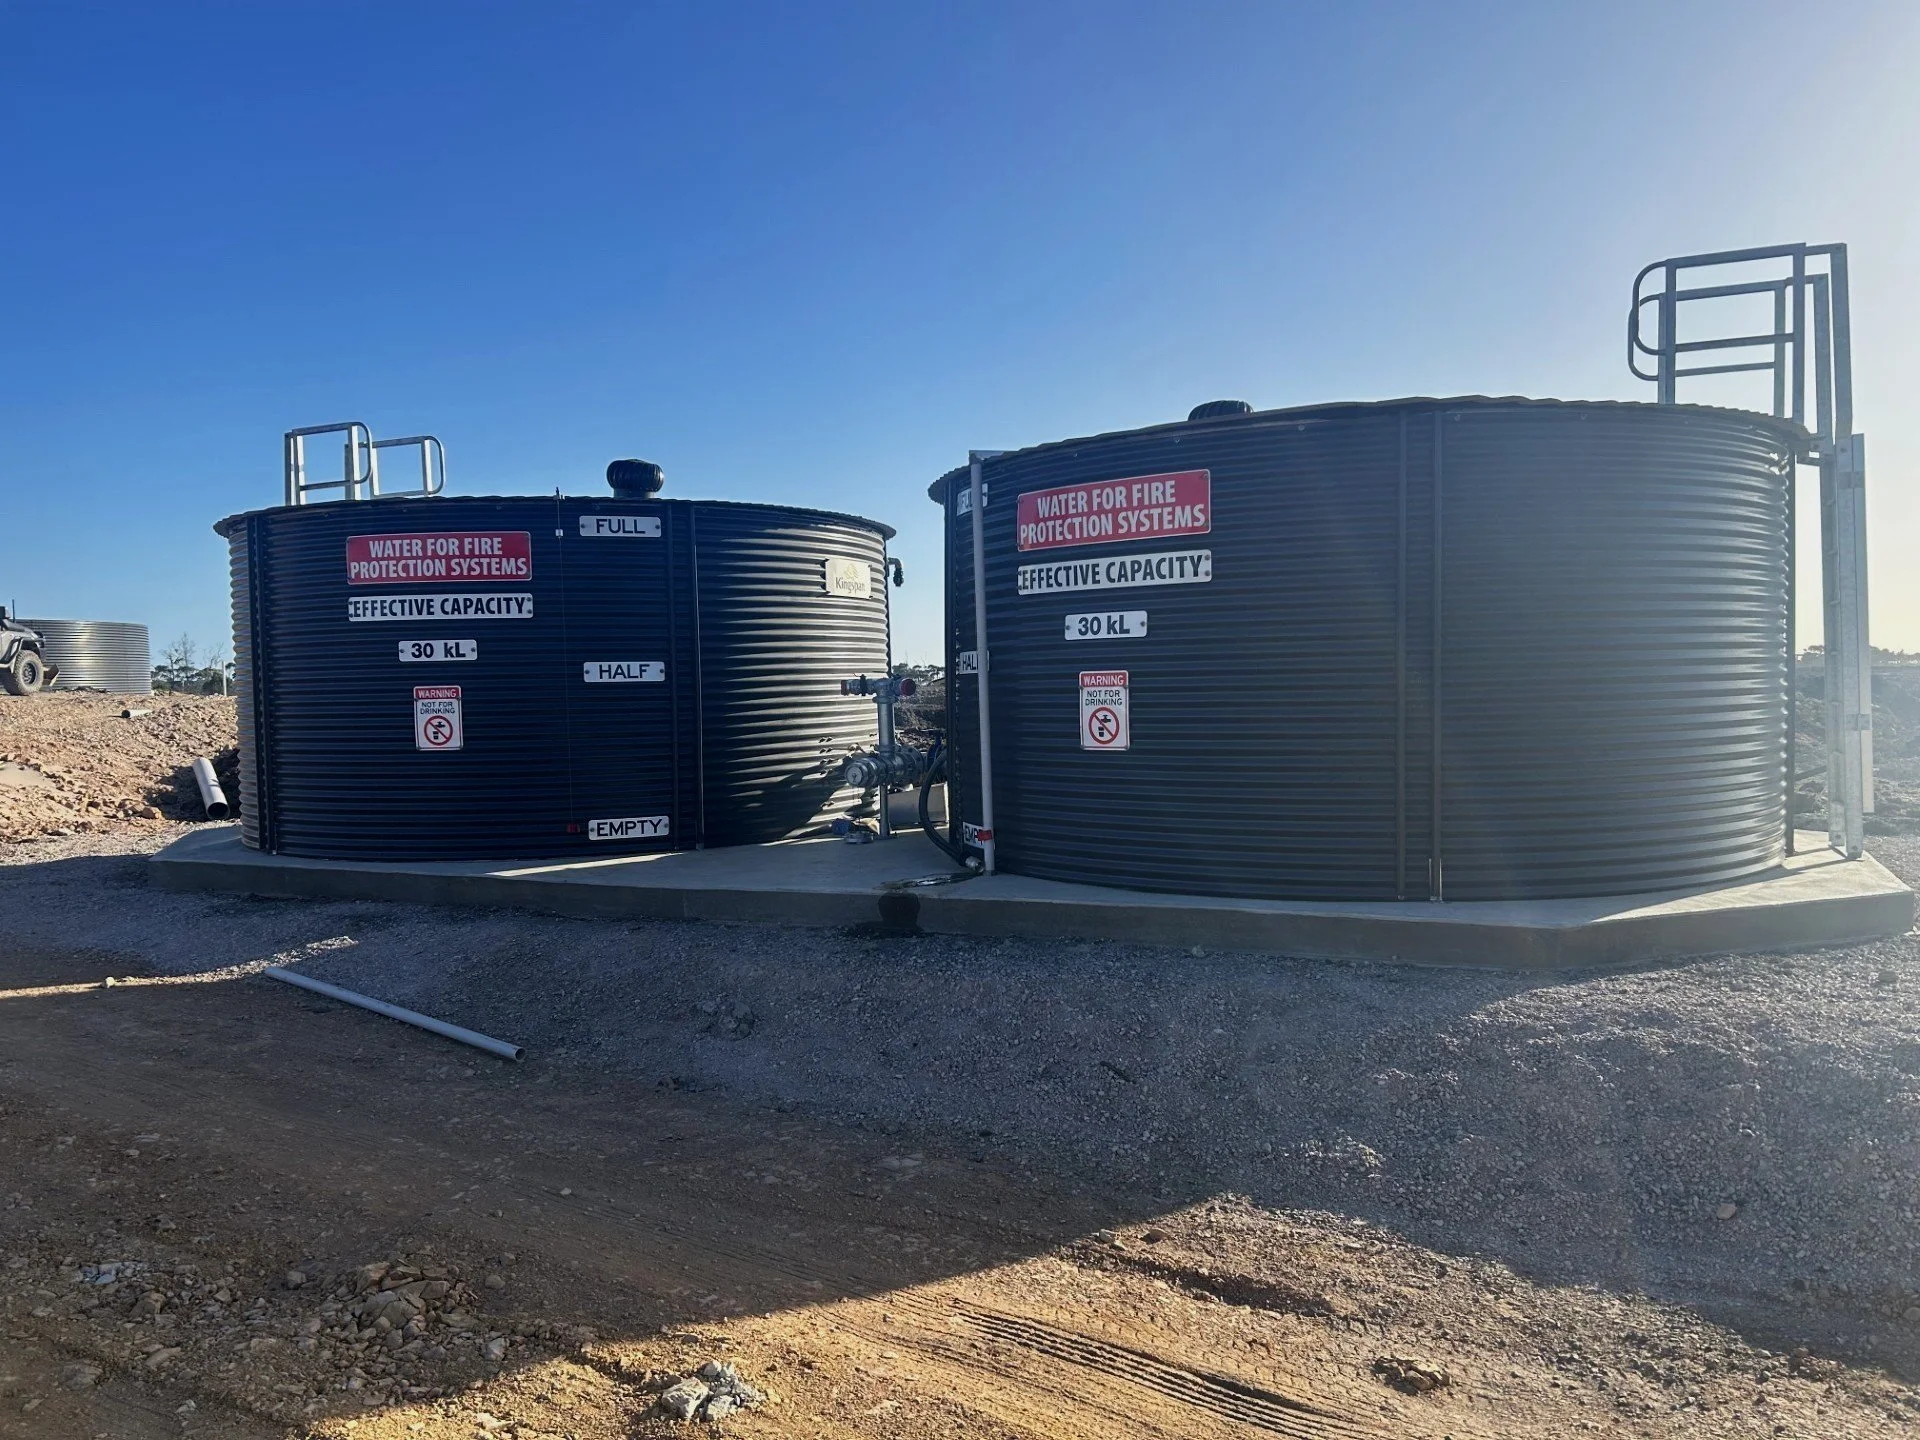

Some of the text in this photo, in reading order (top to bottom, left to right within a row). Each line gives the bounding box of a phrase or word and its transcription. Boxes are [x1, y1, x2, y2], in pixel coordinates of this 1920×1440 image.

[1037, 480, 1176, 519] WATER FOR FIRE
[596, 518, 646, 534] FULL
[1020, 503, 1206, 545] PROTECTION SYSTEMS
[369, 537, 502, 558] WATER FOR FIRE
[351, 557, 528, 579] PROTECTION SYSTEMS
[1022, 554, 1203, 590] EFFECTIVE CAPACITY
[835, 576, 866, 594] Kingspan
[353, 597, 526, 618] EFFECTIVE CAPACITY
[1077, 614, 1130, 636] 30 kL
[411, 642, 466, 659] 30 kL
[963, 654, 979, 671] HAL
[599, 664, 650, 680] HALF
[1083, 675, 1124, 686] WARNING
[418, 688, 457, 699] WARNING
[1085, 698, 1123, 706] DRINKING
[1087, 690, 1120, 698] NOT FOR
[420, 707, 456, 715] DRINKING
[596, 819, 663, 837] EMPTY
